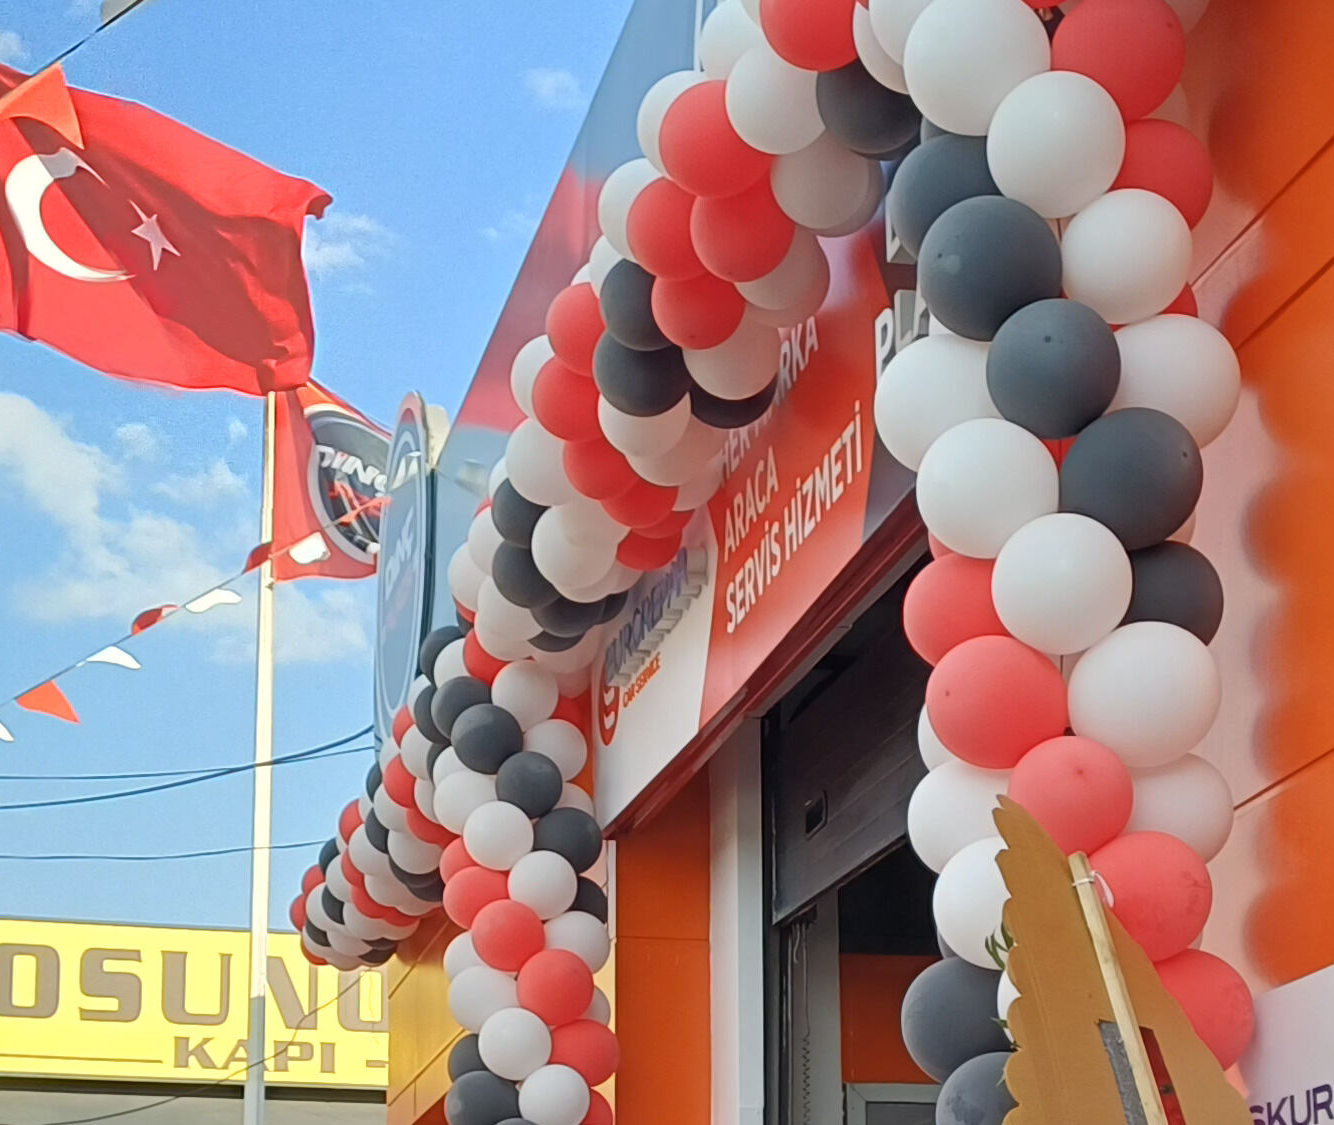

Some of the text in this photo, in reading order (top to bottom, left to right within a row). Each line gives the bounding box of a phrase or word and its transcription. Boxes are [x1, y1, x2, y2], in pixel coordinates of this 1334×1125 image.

[724, 445, 779, 562] ARACA
[726, 400, 862, 634] SERVİS HİZMETİ
[173, 1034, 336, 1074] KAPI
